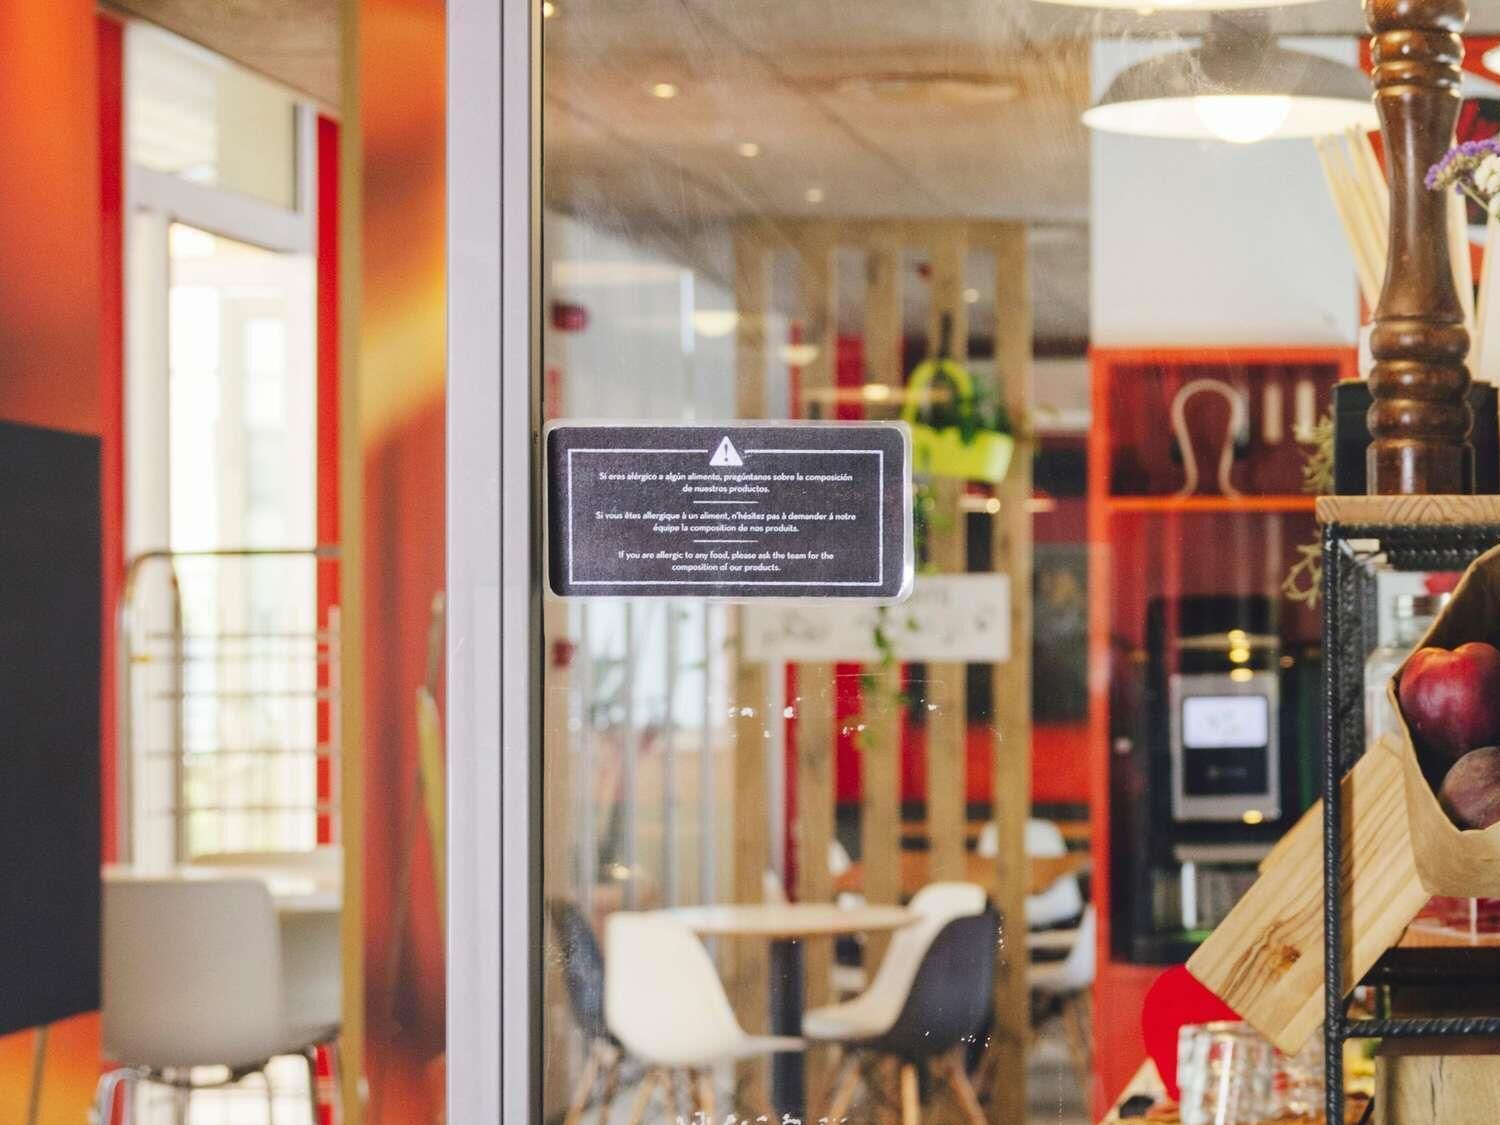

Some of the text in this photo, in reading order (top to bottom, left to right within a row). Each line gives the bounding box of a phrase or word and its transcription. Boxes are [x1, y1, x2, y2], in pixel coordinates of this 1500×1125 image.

[665, 472, 687, 483] algún
[724, 472, 772, 483] pregúntanos
[773, 472, 795, 481] sobre
[805, 472, 853, 483] composición
[683, 484, 693, 493] de
[643, 511, 681, 522] allergique
[766, 514, 781, 522] pas
[788, 511, 828, 520] demander
[653, 523, 680, 534] équipe
[691, 523, 737, 534] composition
[738, 523, 749, 532] de
[626, 553, 641, 562] you
[656, 550, 684, 562] allergic
[695, 553, 709, 562] any
[732, 550, 757, 562] please
[758, 550, 772, 559] ask
[773, 550, 786, 559] the
[787, 552, 807, 560] team
[808, 550, 820, 560] for
[821, 550, 834, 559] the
[672, 563, 719, 573] composition
